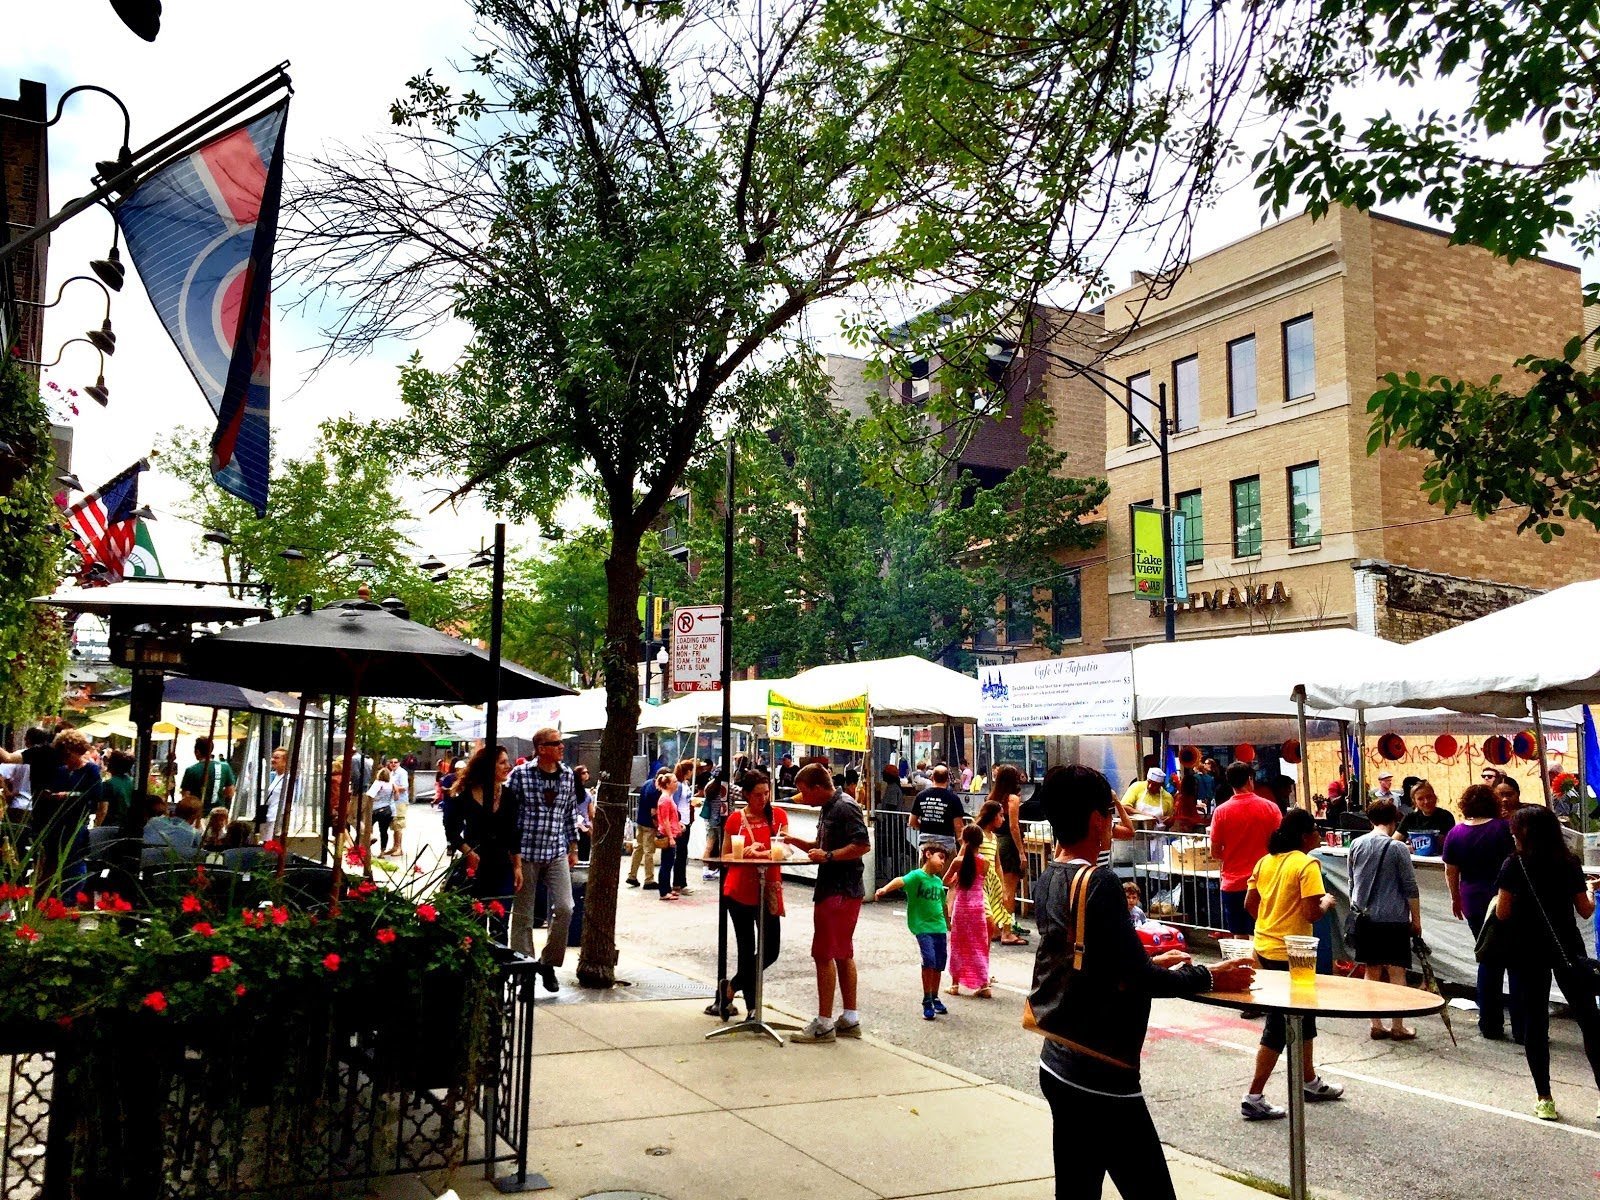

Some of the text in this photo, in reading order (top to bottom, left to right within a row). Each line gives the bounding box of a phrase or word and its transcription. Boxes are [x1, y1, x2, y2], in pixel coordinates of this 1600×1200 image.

[1137, 554, 1162, 565] Lake
[1137, 565, 1162, 574] view
[676, 681, 718, 690] TOW ZE
